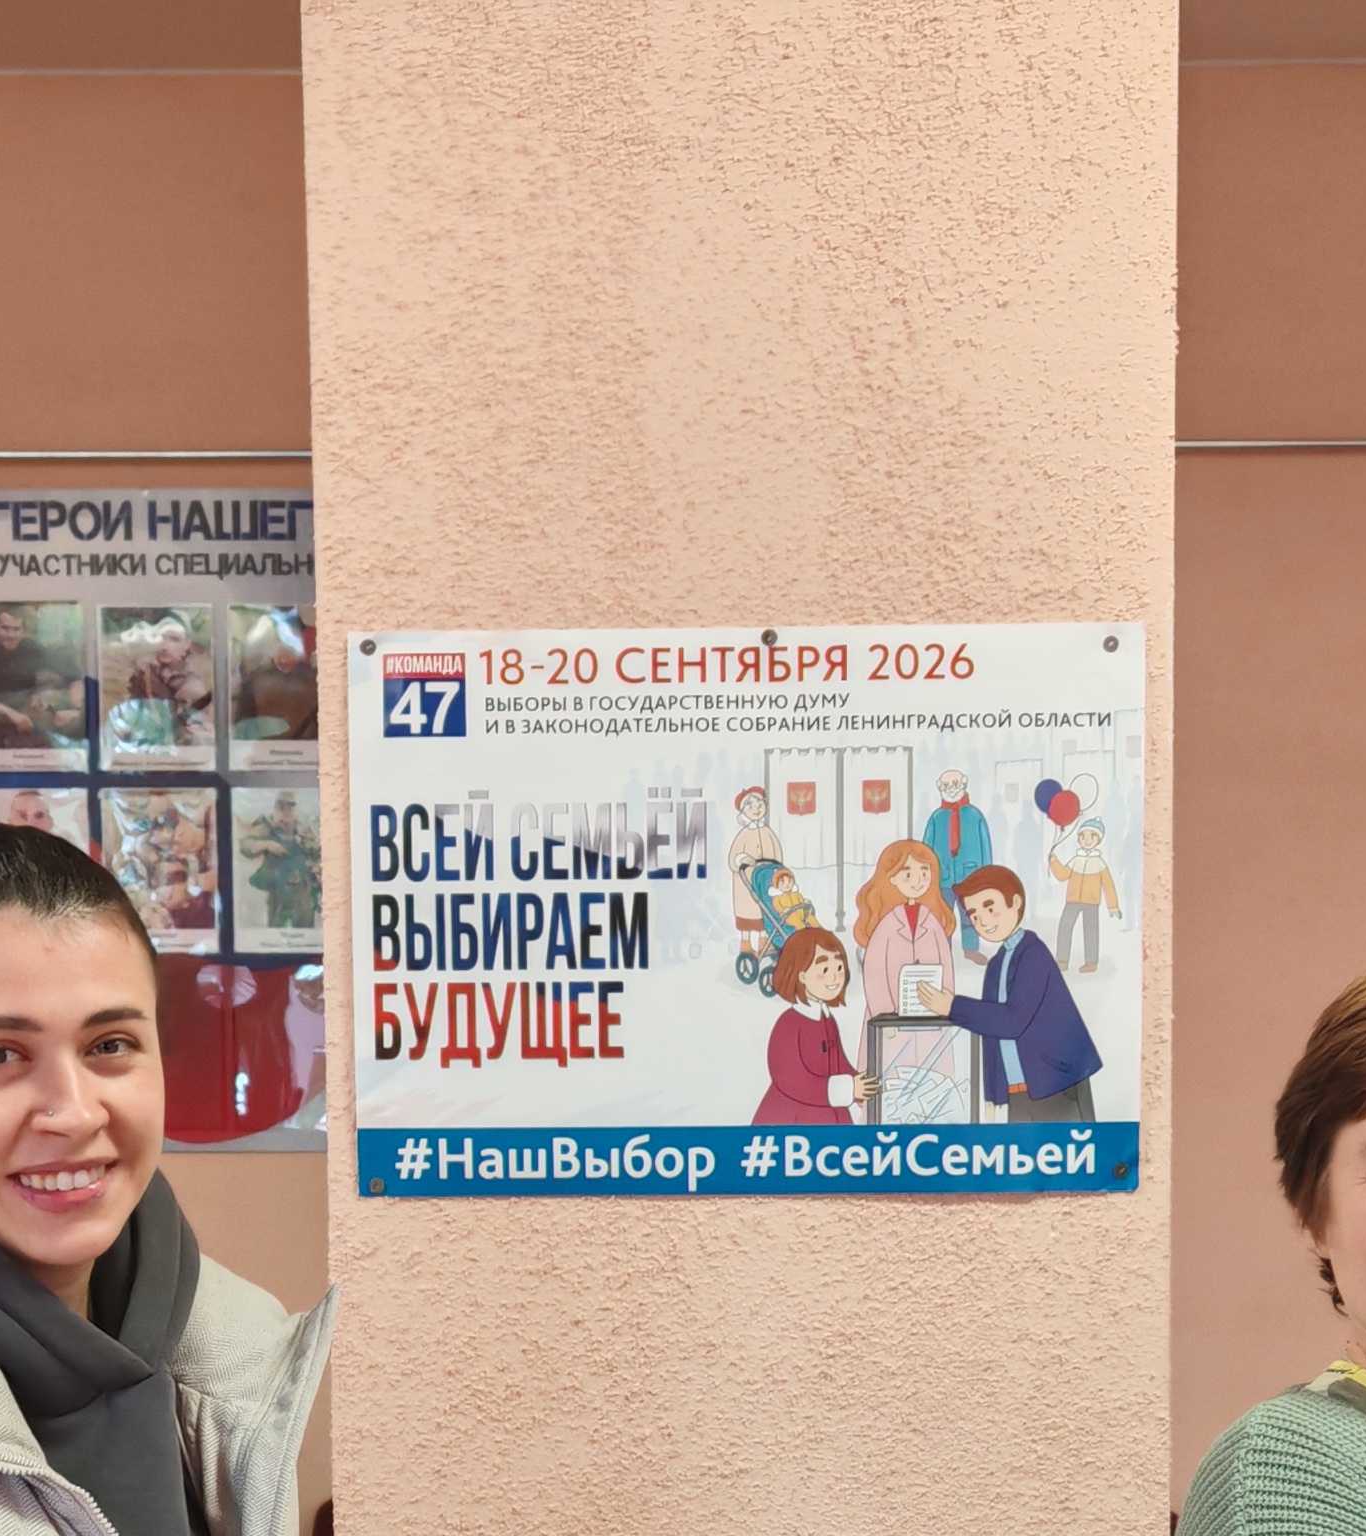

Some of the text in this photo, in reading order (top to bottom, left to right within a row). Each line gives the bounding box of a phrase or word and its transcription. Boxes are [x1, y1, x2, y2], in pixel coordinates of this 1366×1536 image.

[148, 500, 314, 541] НАШЕГ
[154, 552, 314, 581] СПЕЦИАЛЬН
[386, 653, 463, 675] #КОМАНДА
[479, 642, 975, 686] 18-20 СЕНТЯБРЯ 2026
[390, 681, 461, 735] 47
[485, 692, 850, 714] ВЫБОРЫ В ГОСУДАРСТВЕННУЮ ДУМУ
[485, 709, 1112, 738] И В ЗАКОНОДАТЕЛЬНОЕ СОБРАНИЕ ЛЕНИНГРАДСКОЙ ОБЛАСТИ
[370, 786, 708, 882] ВСЕЙ СЕМЬЁЙ
[371, 891, 650, 972] ВЫБИРАЕМ
[373, 980, 626, 1069] БУДУЩЕЕ
[395, 1129, 1097, 1193] #НашВыбор #ВсейСемьей
